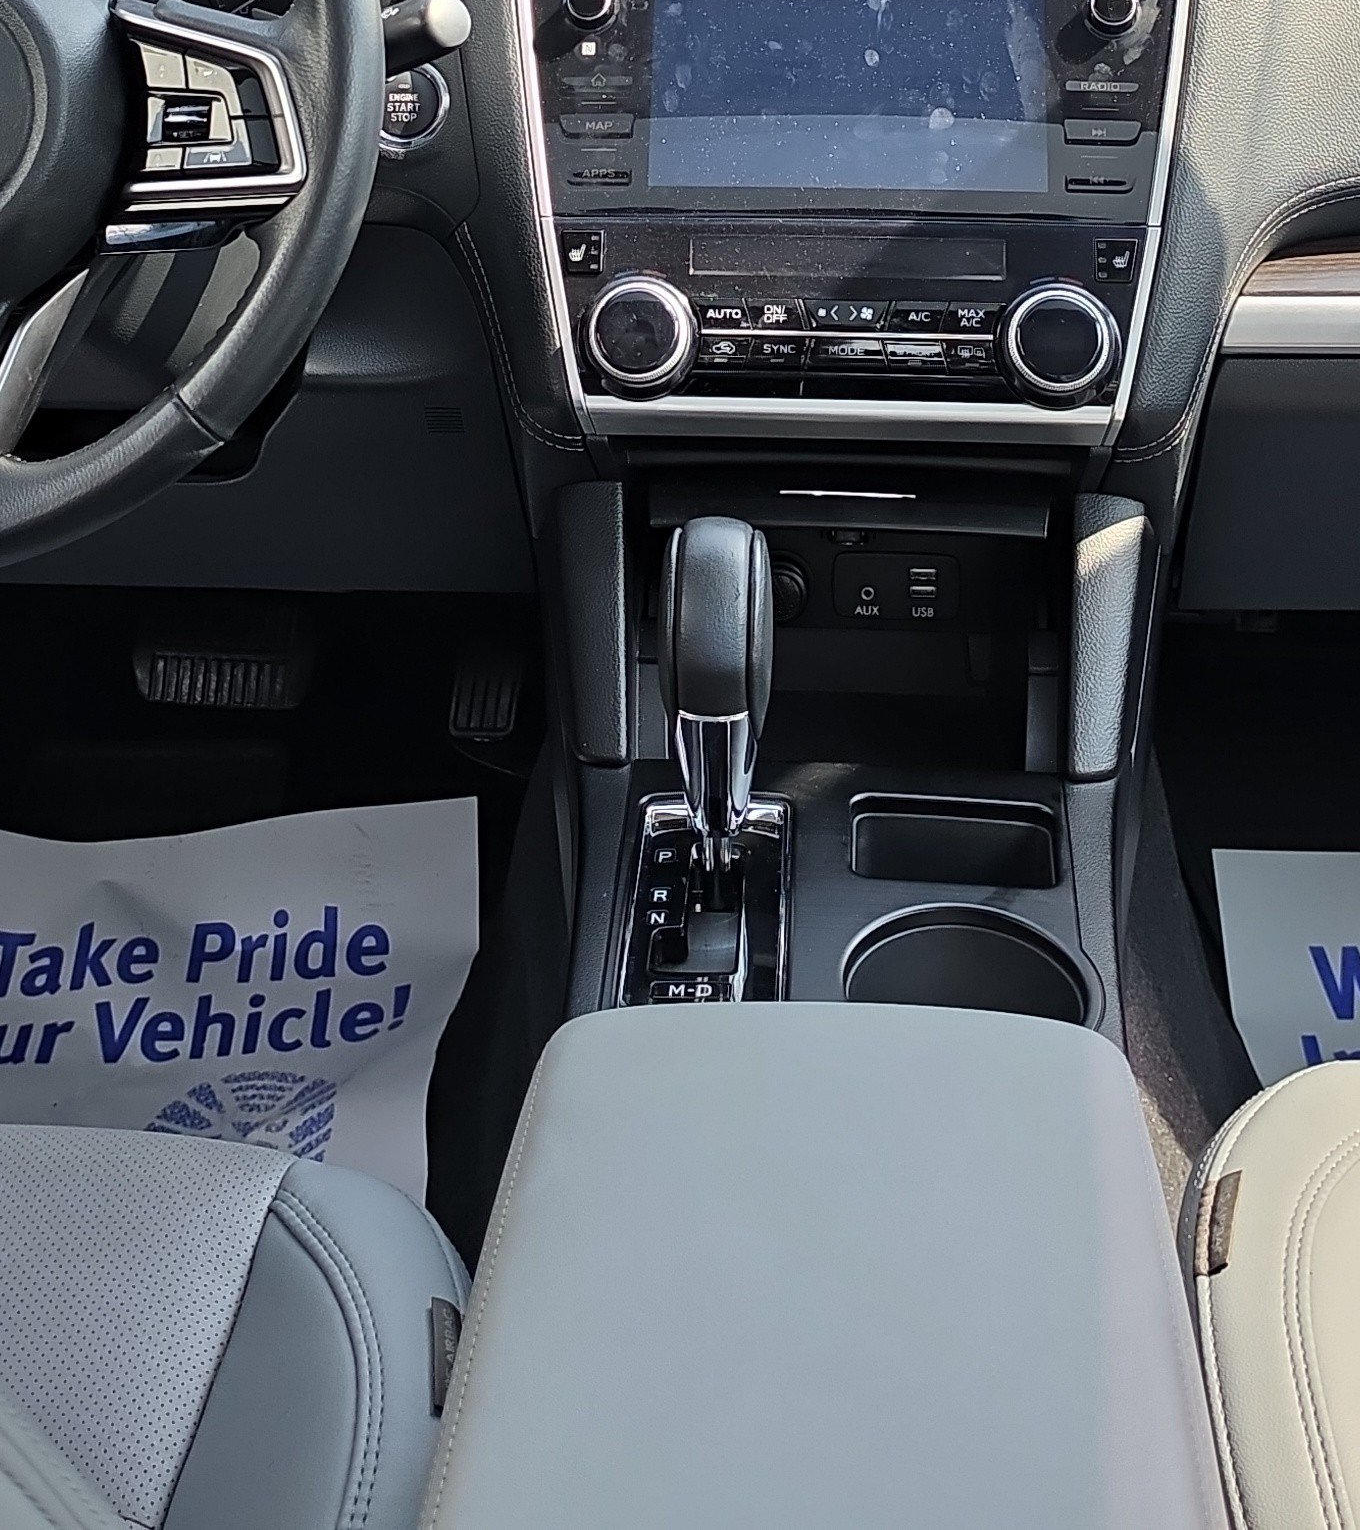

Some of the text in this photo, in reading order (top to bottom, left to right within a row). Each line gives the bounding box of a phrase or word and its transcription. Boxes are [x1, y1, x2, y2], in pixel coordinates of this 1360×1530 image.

[1080, 81, 1120, 91] RADIO
[388, 92, 419, 102] ENGINE
[387, 102, 420, 112] START
[390, 112, 418, 122] STOP
[585, 120, 613, 131] MAP
[582, 168, 615, 178] APPS
[706, 308, 742, 319] AUTO
[908, 311, 931, 322] A/C
[957, 307, 984, 318] MAX
[763, 313, 788, 324] OFF
[960, 317, 981, 328] A/C
[762, 344, 796, 355] SYNC
[828, 345, 865, 356] MODE
[854, 605, 879, 616] AUX
[912, 607, 934, 617] USB
[659, 851, 673, 863] P
[653, 890, 668, 902] R
[650, 912, 665, 925] N
[186, 906, 391, 984] Pride
[93, 984, 412, 1064] Vehicle!
